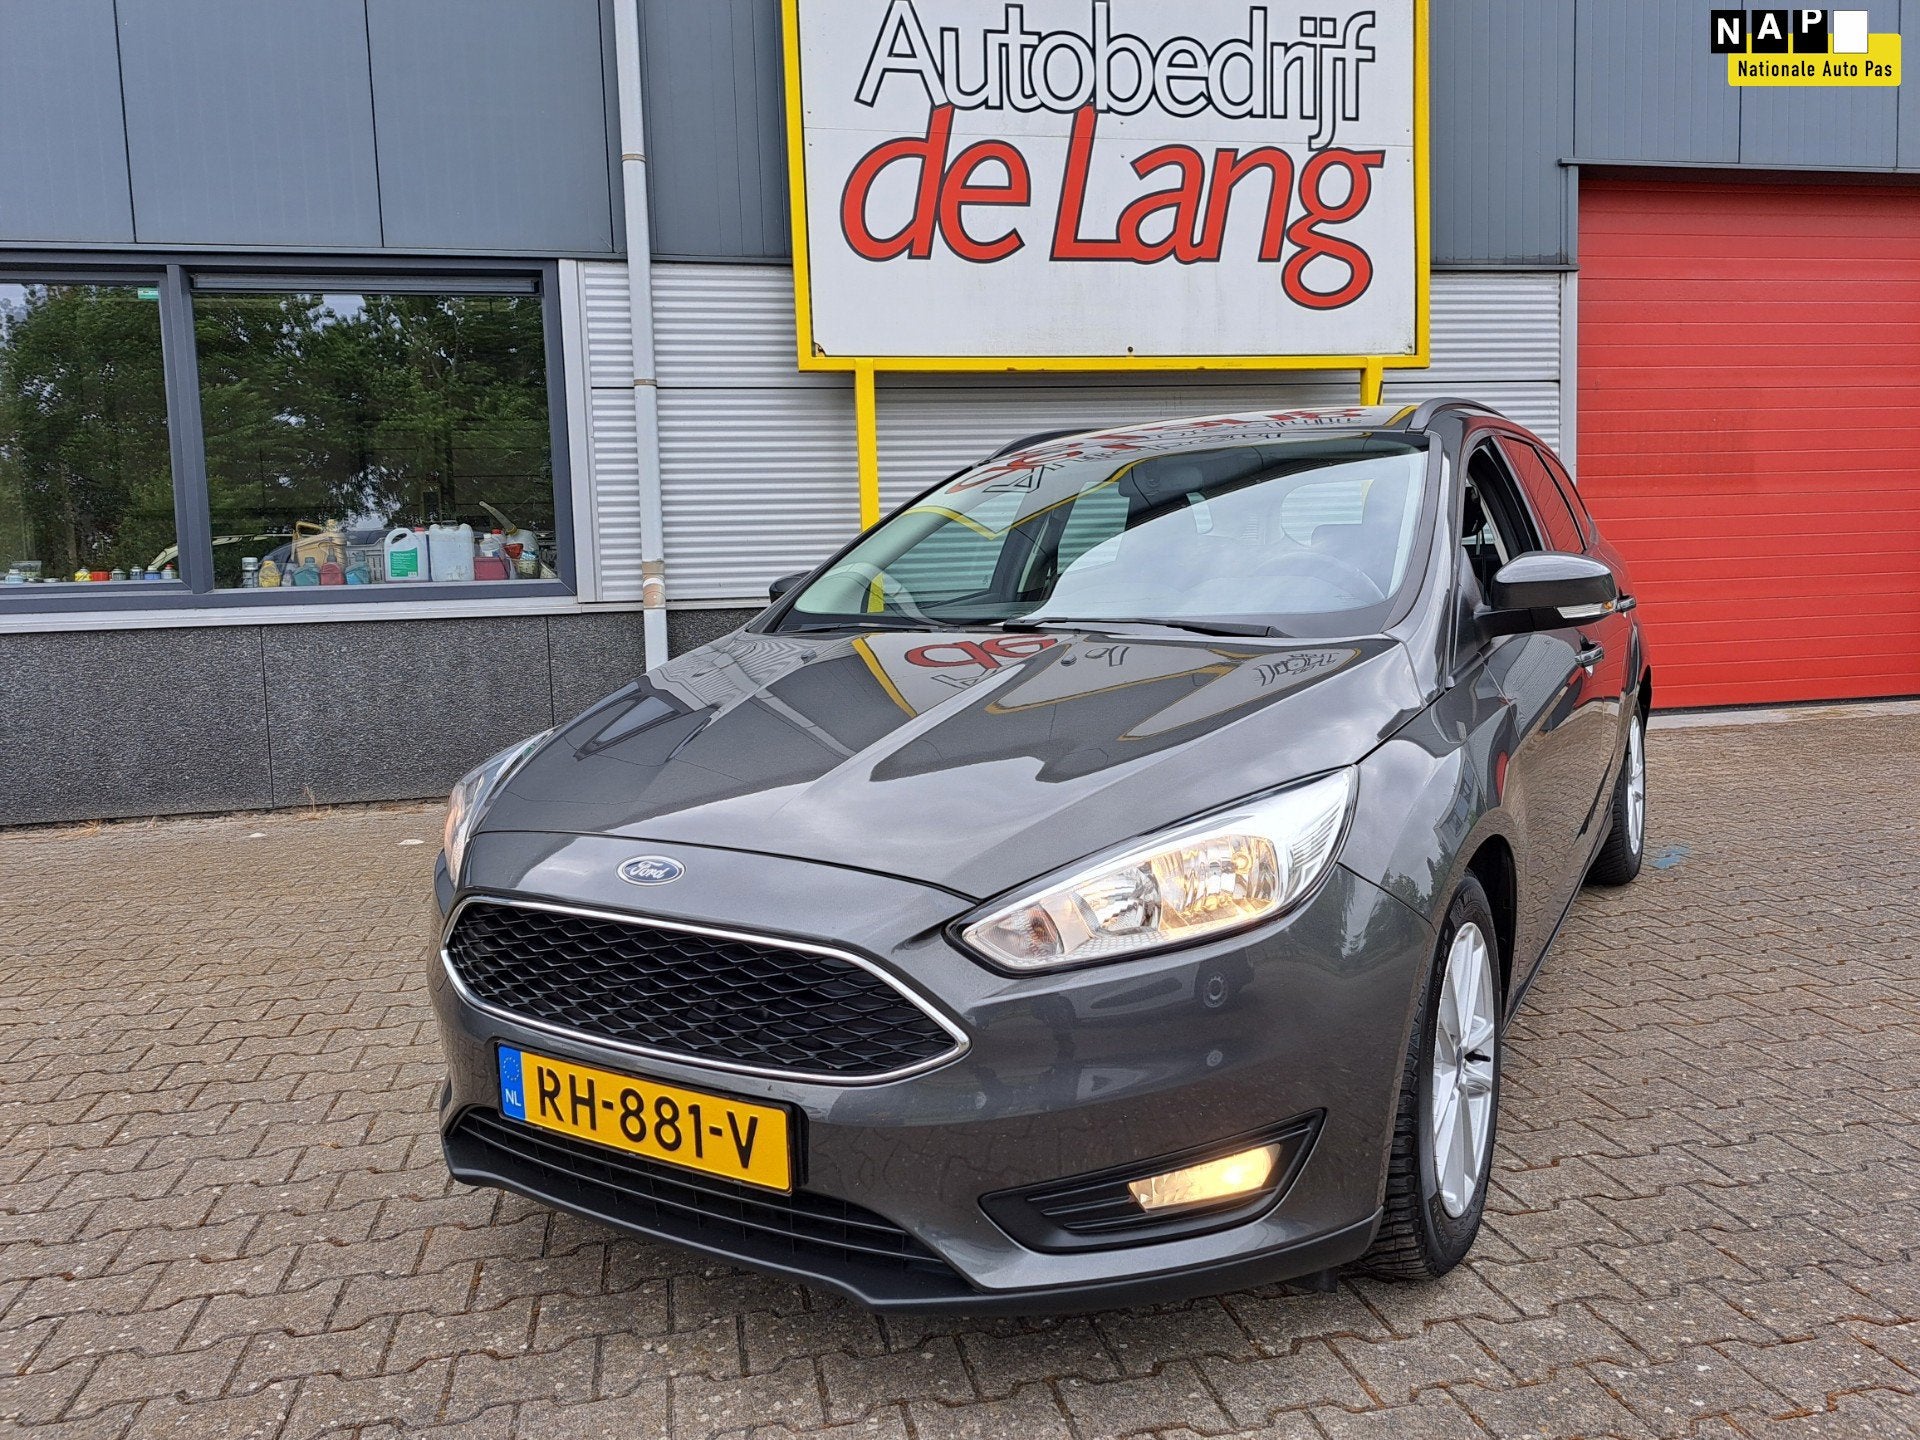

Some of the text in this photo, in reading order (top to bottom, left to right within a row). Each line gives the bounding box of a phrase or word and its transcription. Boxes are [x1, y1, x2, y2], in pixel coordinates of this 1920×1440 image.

[855, 0, 1376, 150] Autobedrijf
[840, 102, 1386, 311] de Lang
[629, 860, 670, 880] Ford
[505, 1088, 522, 1108] NL
[536, 1065, 759, 1170] RH-881-V
